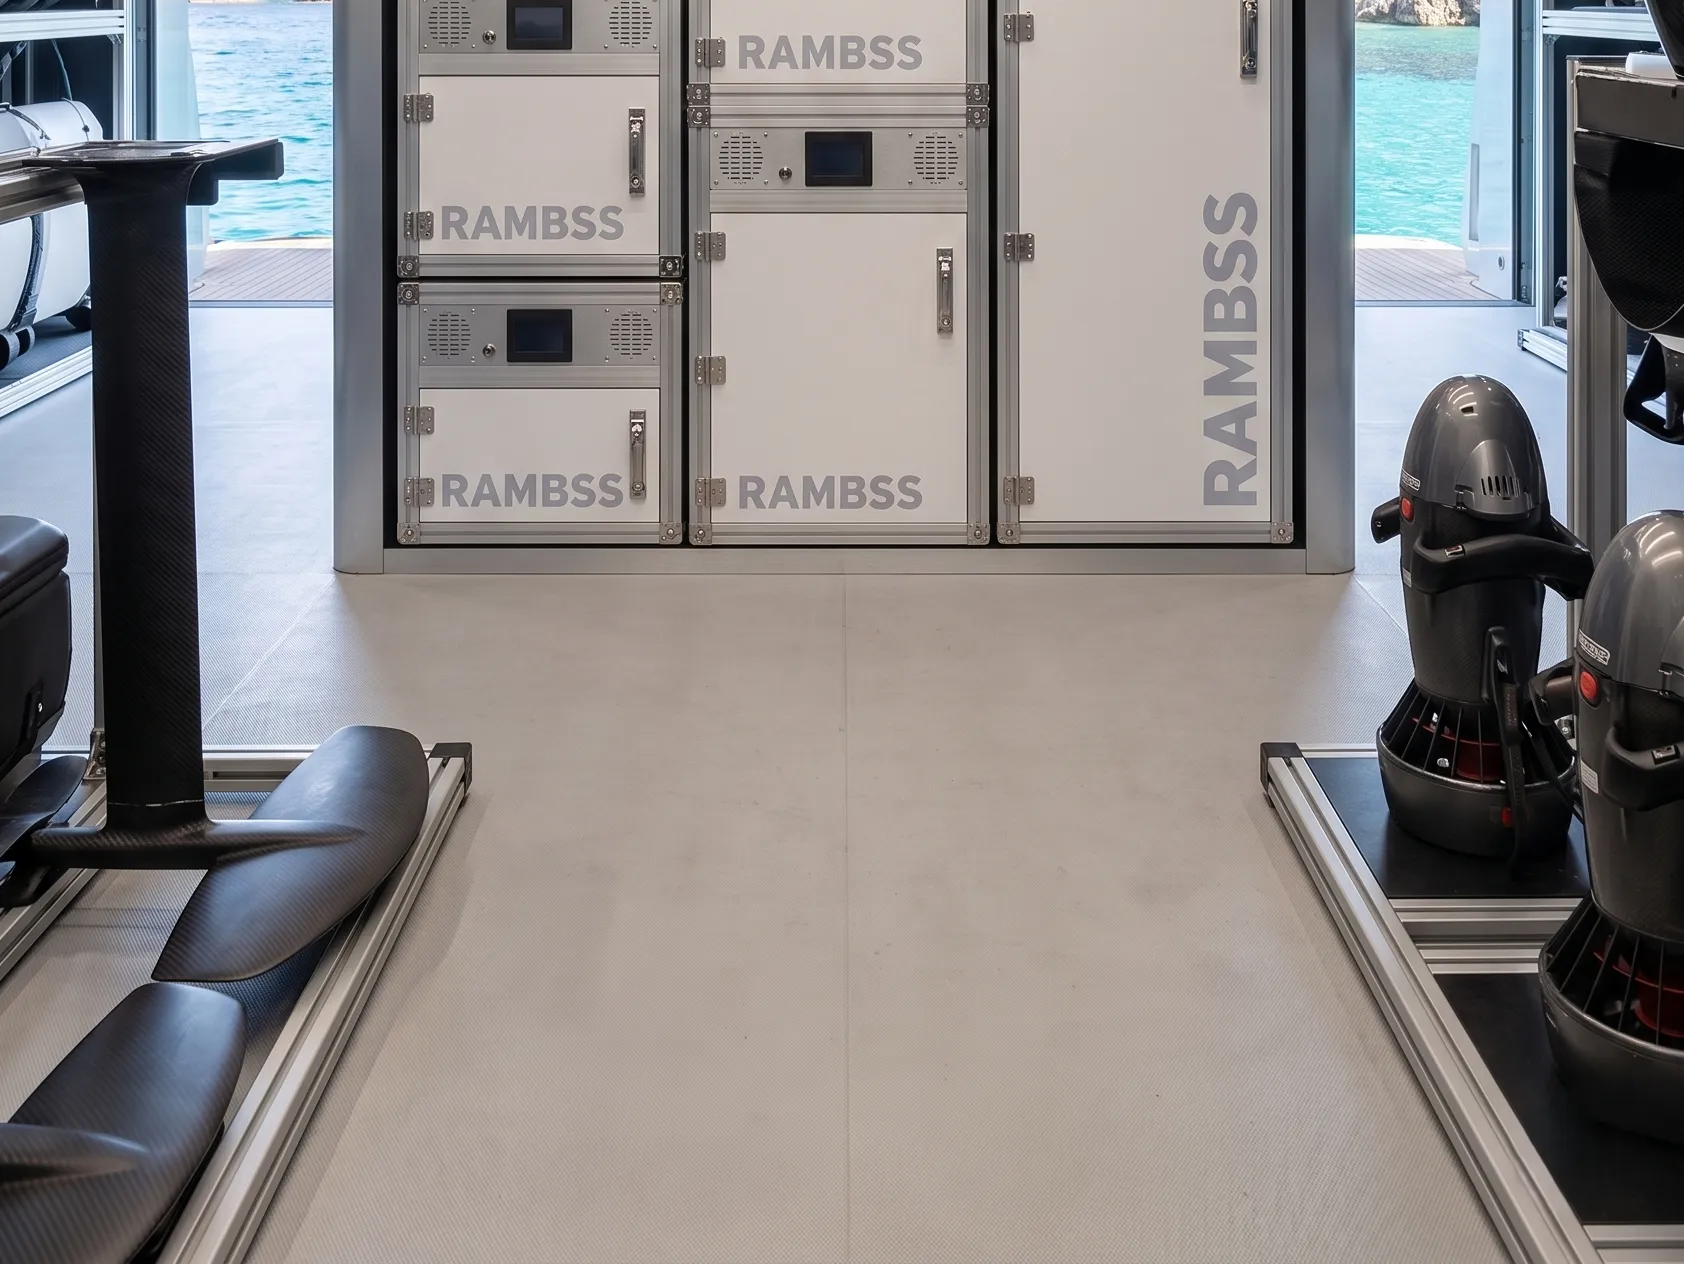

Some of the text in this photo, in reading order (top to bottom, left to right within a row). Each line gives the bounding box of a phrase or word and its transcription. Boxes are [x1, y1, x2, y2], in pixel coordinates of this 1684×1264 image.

[739, 35, 922, 70] RAMBSS
[442, 206, 623, 240] RAMBSS
[1203, 193, 1257, 505] RAMBSS
[442, 474, 623, 508] RAMBSS
[739, 475, 922, 510] RAMBSS
